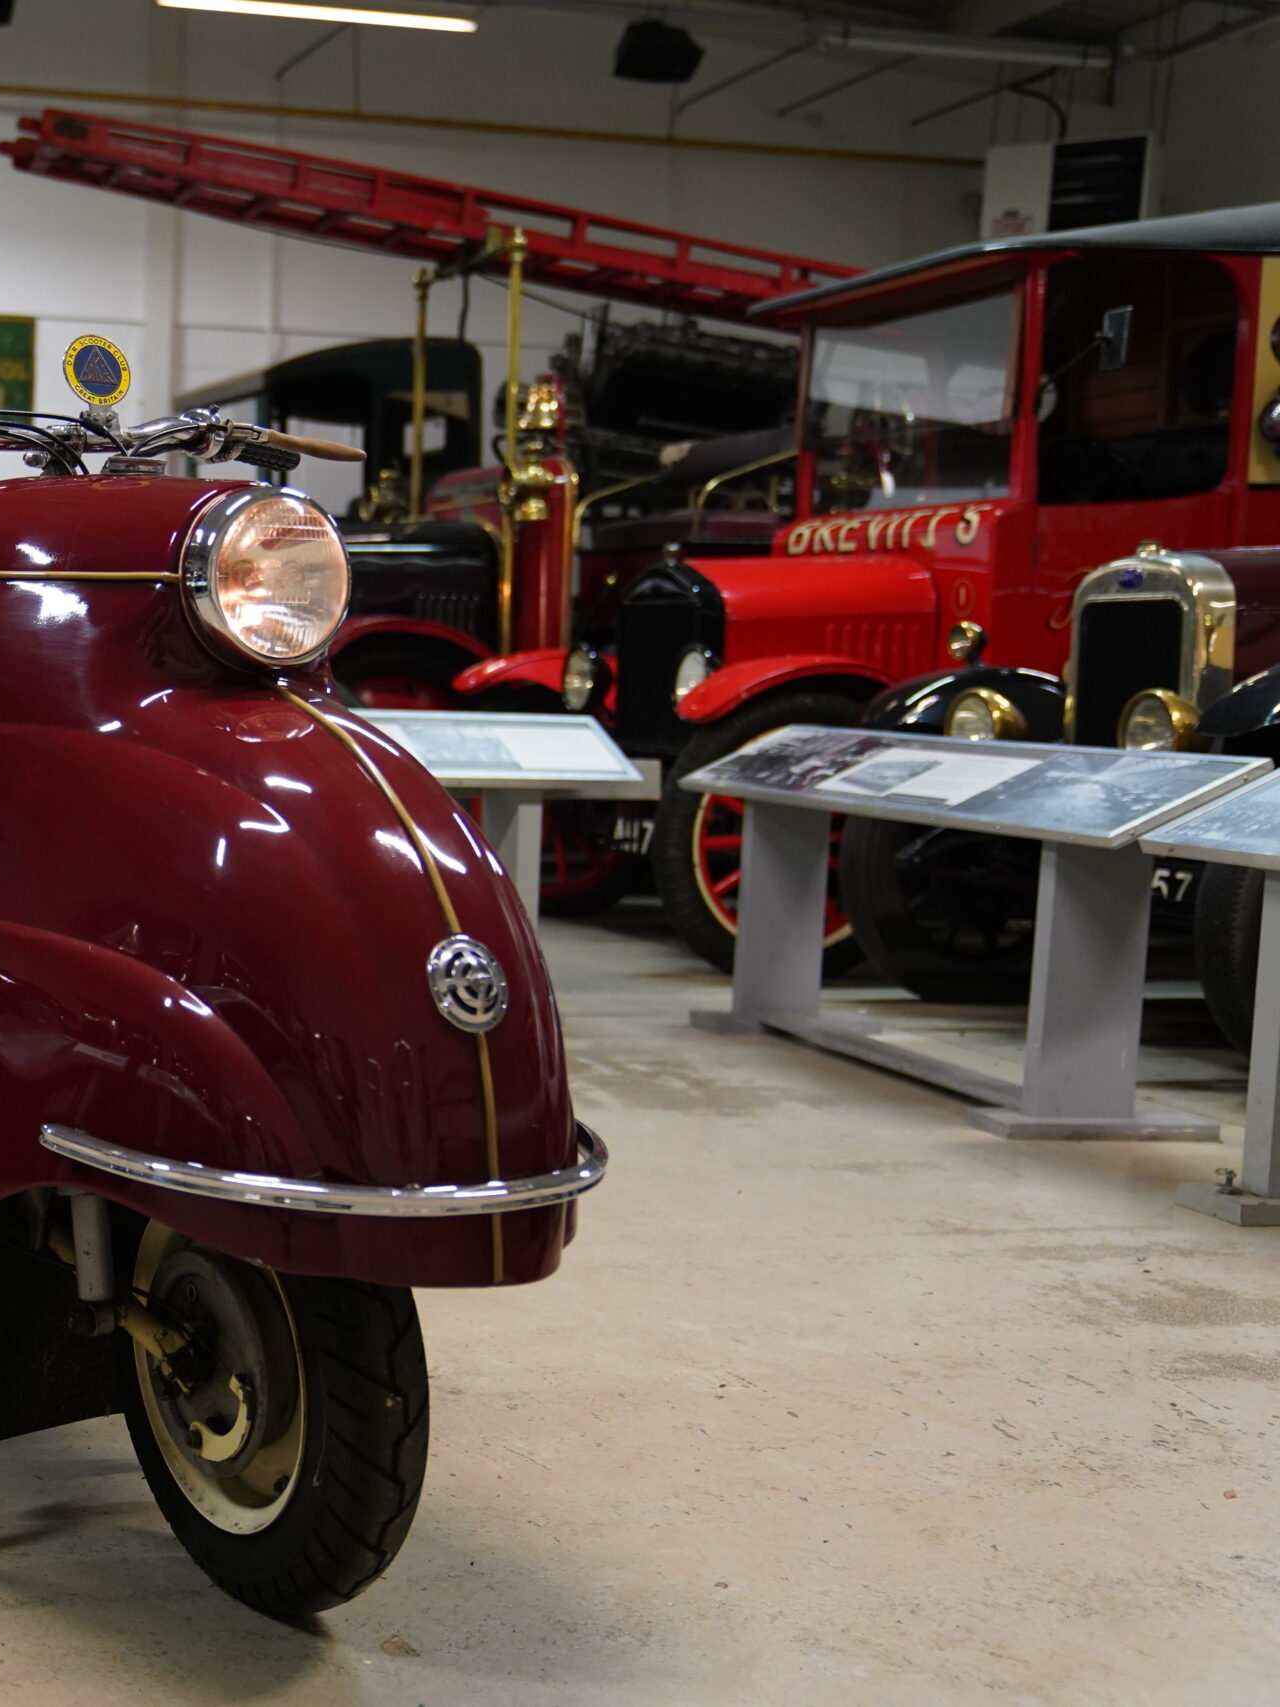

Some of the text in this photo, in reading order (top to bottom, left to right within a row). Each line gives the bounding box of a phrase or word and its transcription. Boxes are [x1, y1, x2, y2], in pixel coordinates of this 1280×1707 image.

[66, 338, 128, 372] DKR SCOOTER CLUB
[74, 384, 124, 405] GREAT BRITAIN
